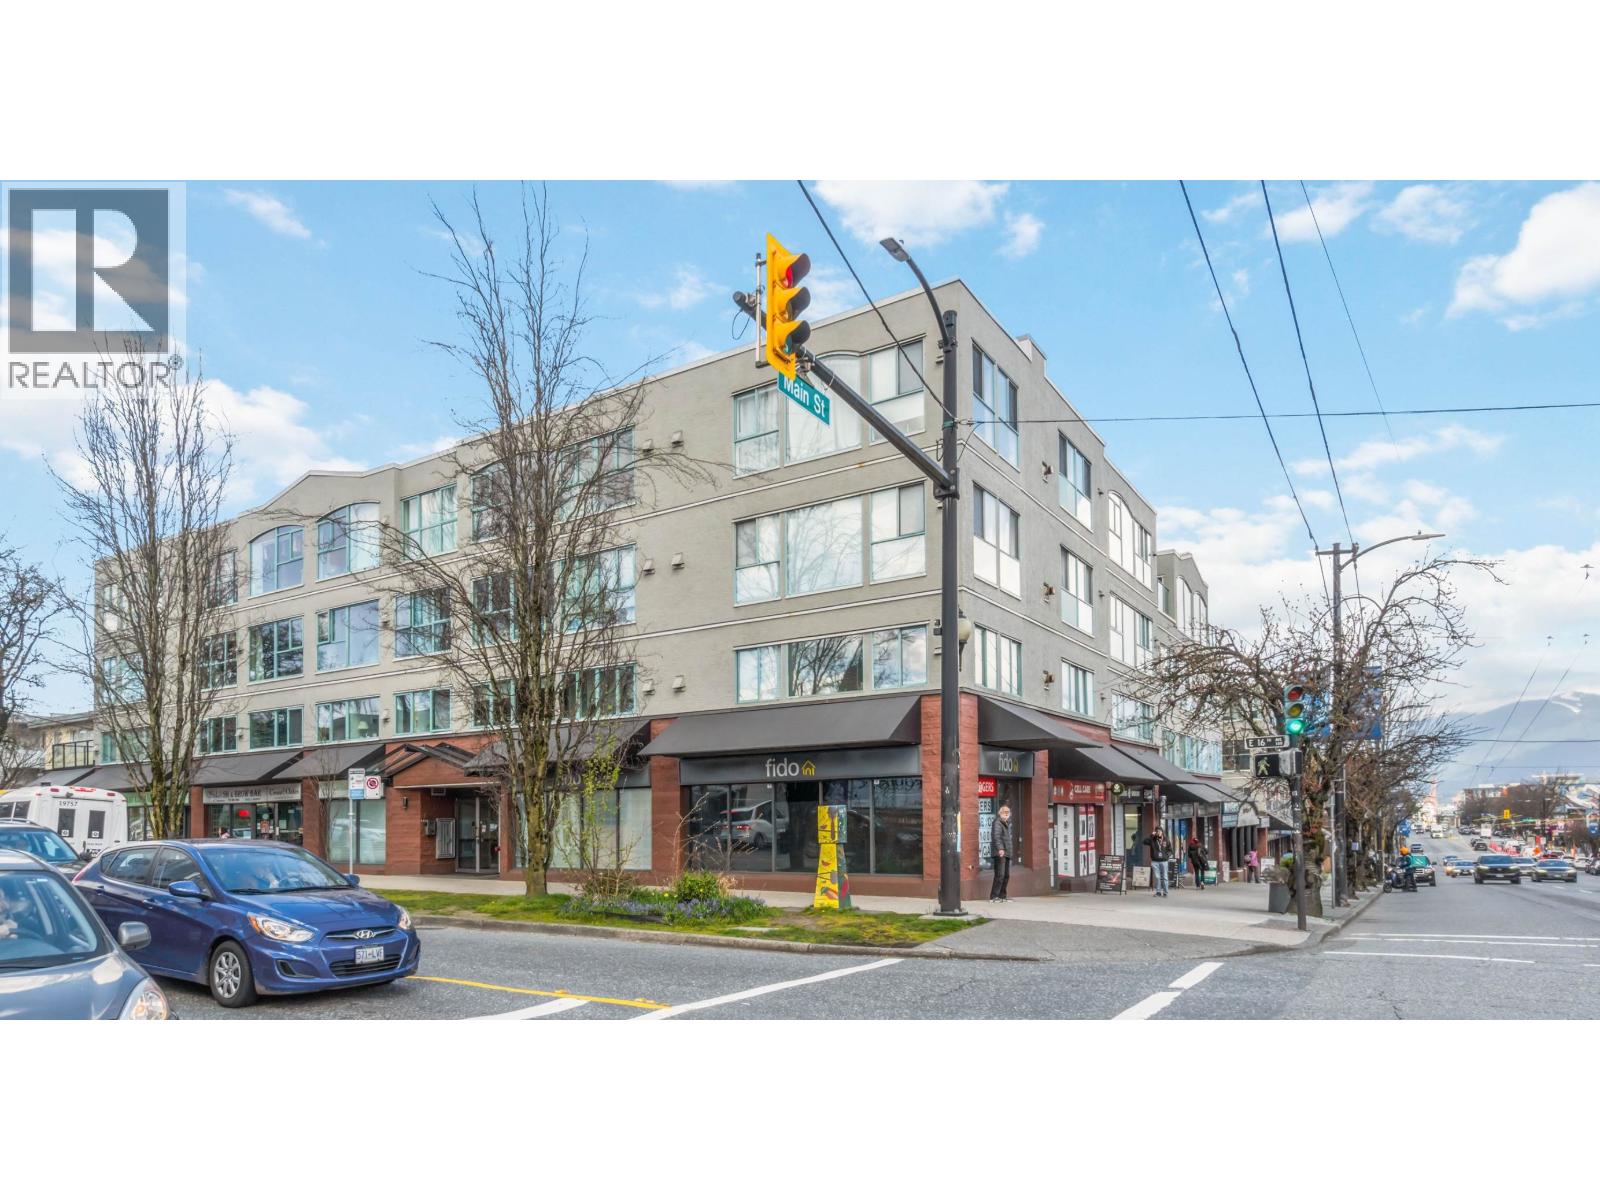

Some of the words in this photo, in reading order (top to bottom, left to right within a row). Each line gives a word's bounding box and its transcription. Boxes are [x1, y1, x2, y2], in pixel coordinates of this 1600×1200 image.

[783, 376, 809, 406] Main
[813, 393, 825, 417] St
[1248, 739, 1254, 747] E
[765, 757, 800, 777] fido
[999, 752, 1012, 771] fido
